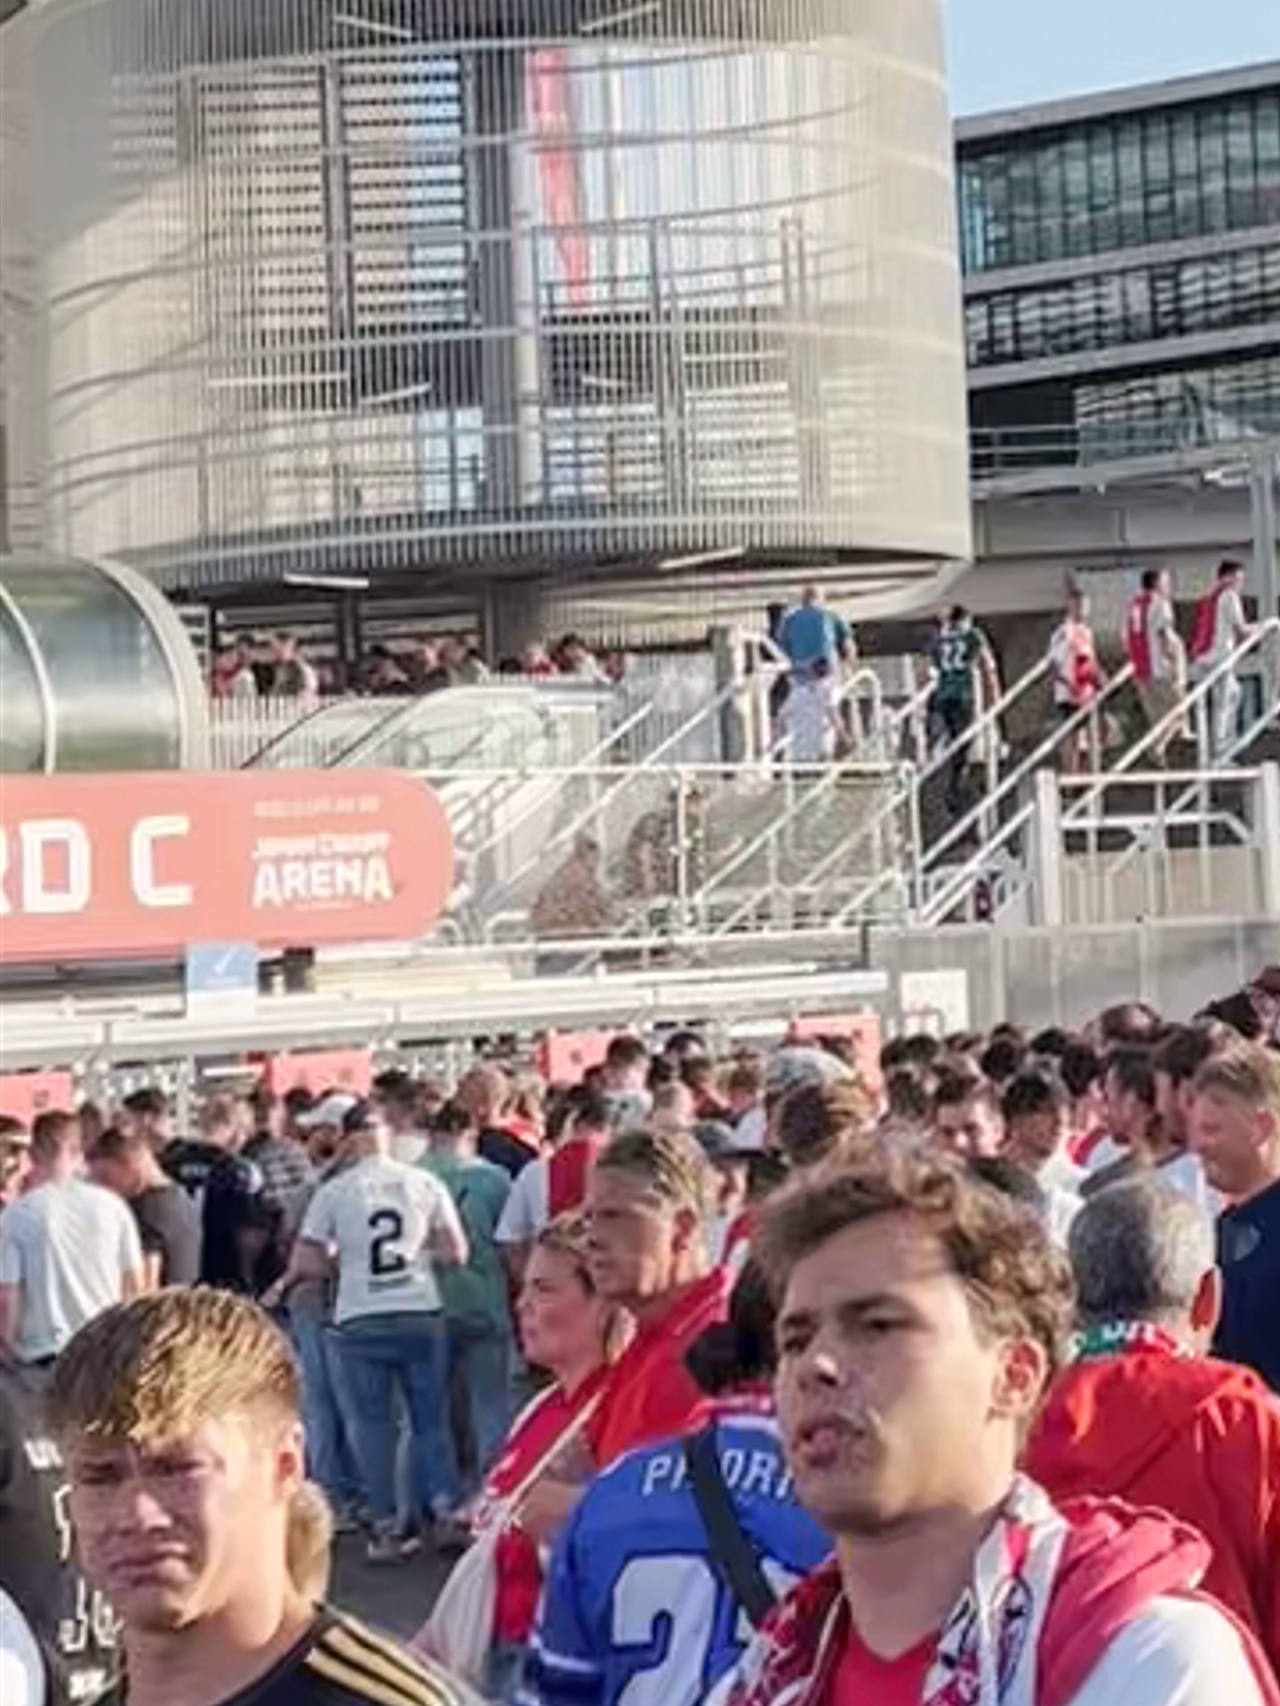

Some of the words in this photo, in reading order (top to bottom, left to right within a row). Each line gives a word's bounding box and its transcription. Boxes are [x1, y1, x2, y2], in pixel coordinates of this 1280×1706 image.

[0, 818, 92, 914] D
[131, 815, 193, 907] C
[251, 855, 394, 909] ARENA
[367, 1208, 406, 1275] 2
